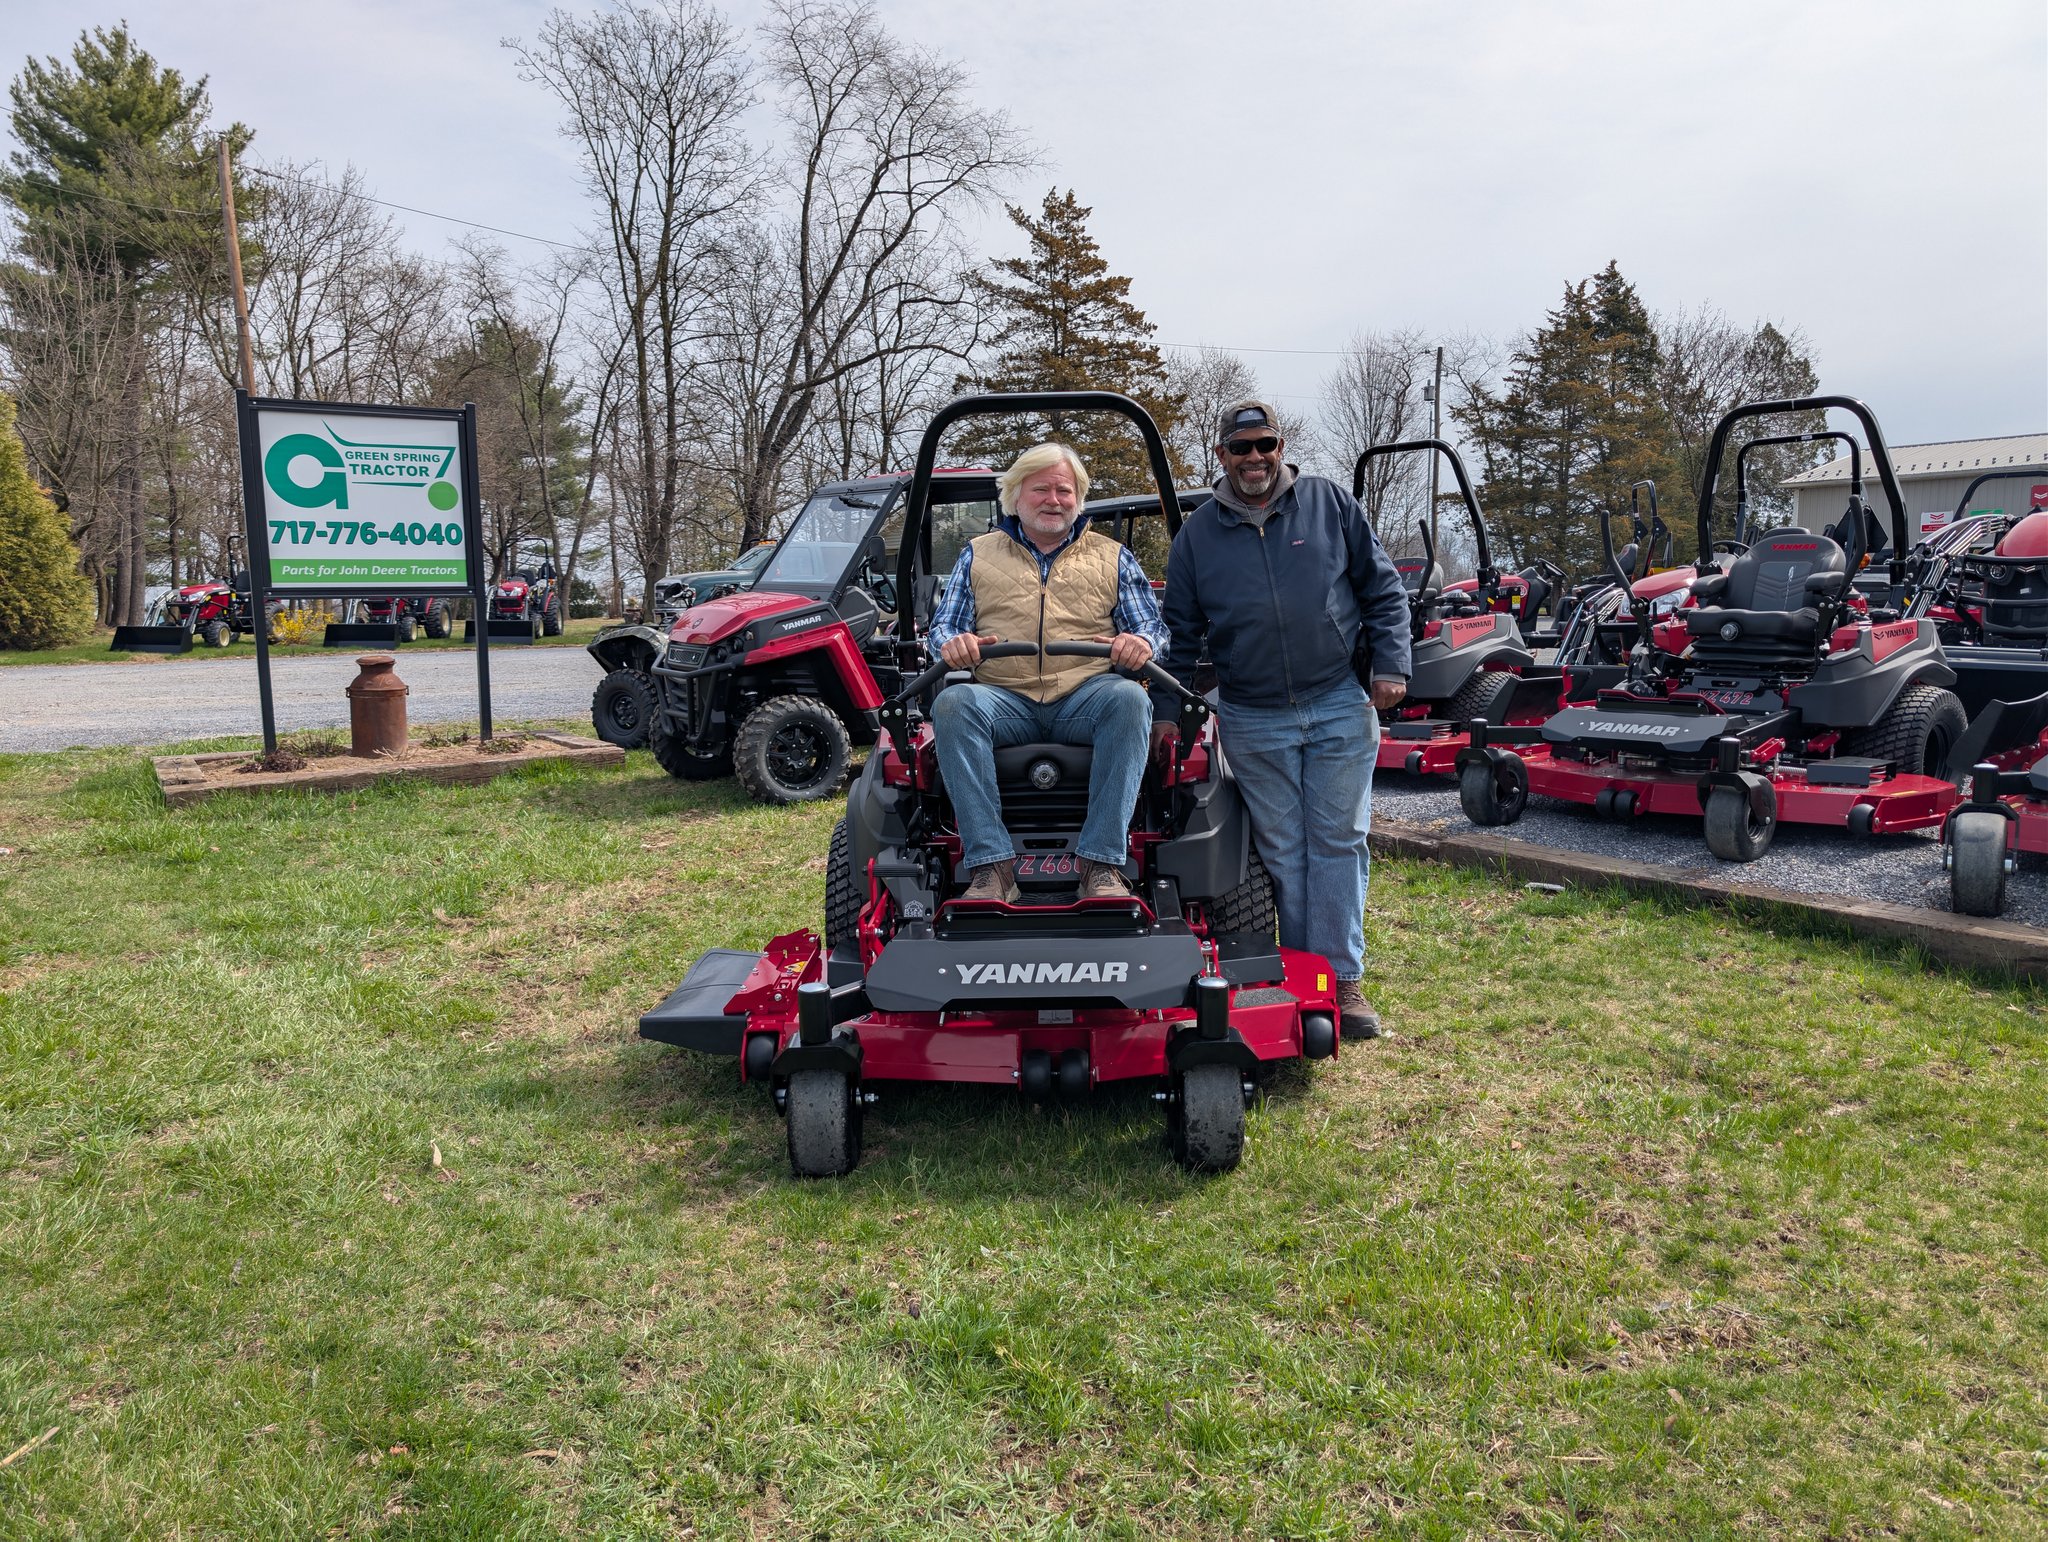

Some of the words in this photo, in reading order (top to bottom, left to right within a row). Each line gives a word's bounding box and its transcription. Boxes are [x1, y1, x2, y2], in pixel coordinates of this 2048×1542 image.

[345, 450, 389, 462] GREEN
[393, 452, 441, 463] SPRING
[348, 463, 430, 477] TRACTOR
[268, 520, 463, 545] 717-776-4040
[281, 565, 315, 576] Parts
[317, 565, 337, 578] for
[338, 565, 368, 576] John
[371, 565, 407, 576] Deere
[410, 565, 458, 576] Tractors
[782, 615, 822, 630] YANMAR
[1464, 620, 1492, 630] YANMAR
[1884, 627, 1914, 638] YANMAR
[1719, 690, 1754, 705] 472
[1588, 721, 1681, 737] YANMAR
[955, 962, 1129, 984] YANMAR
